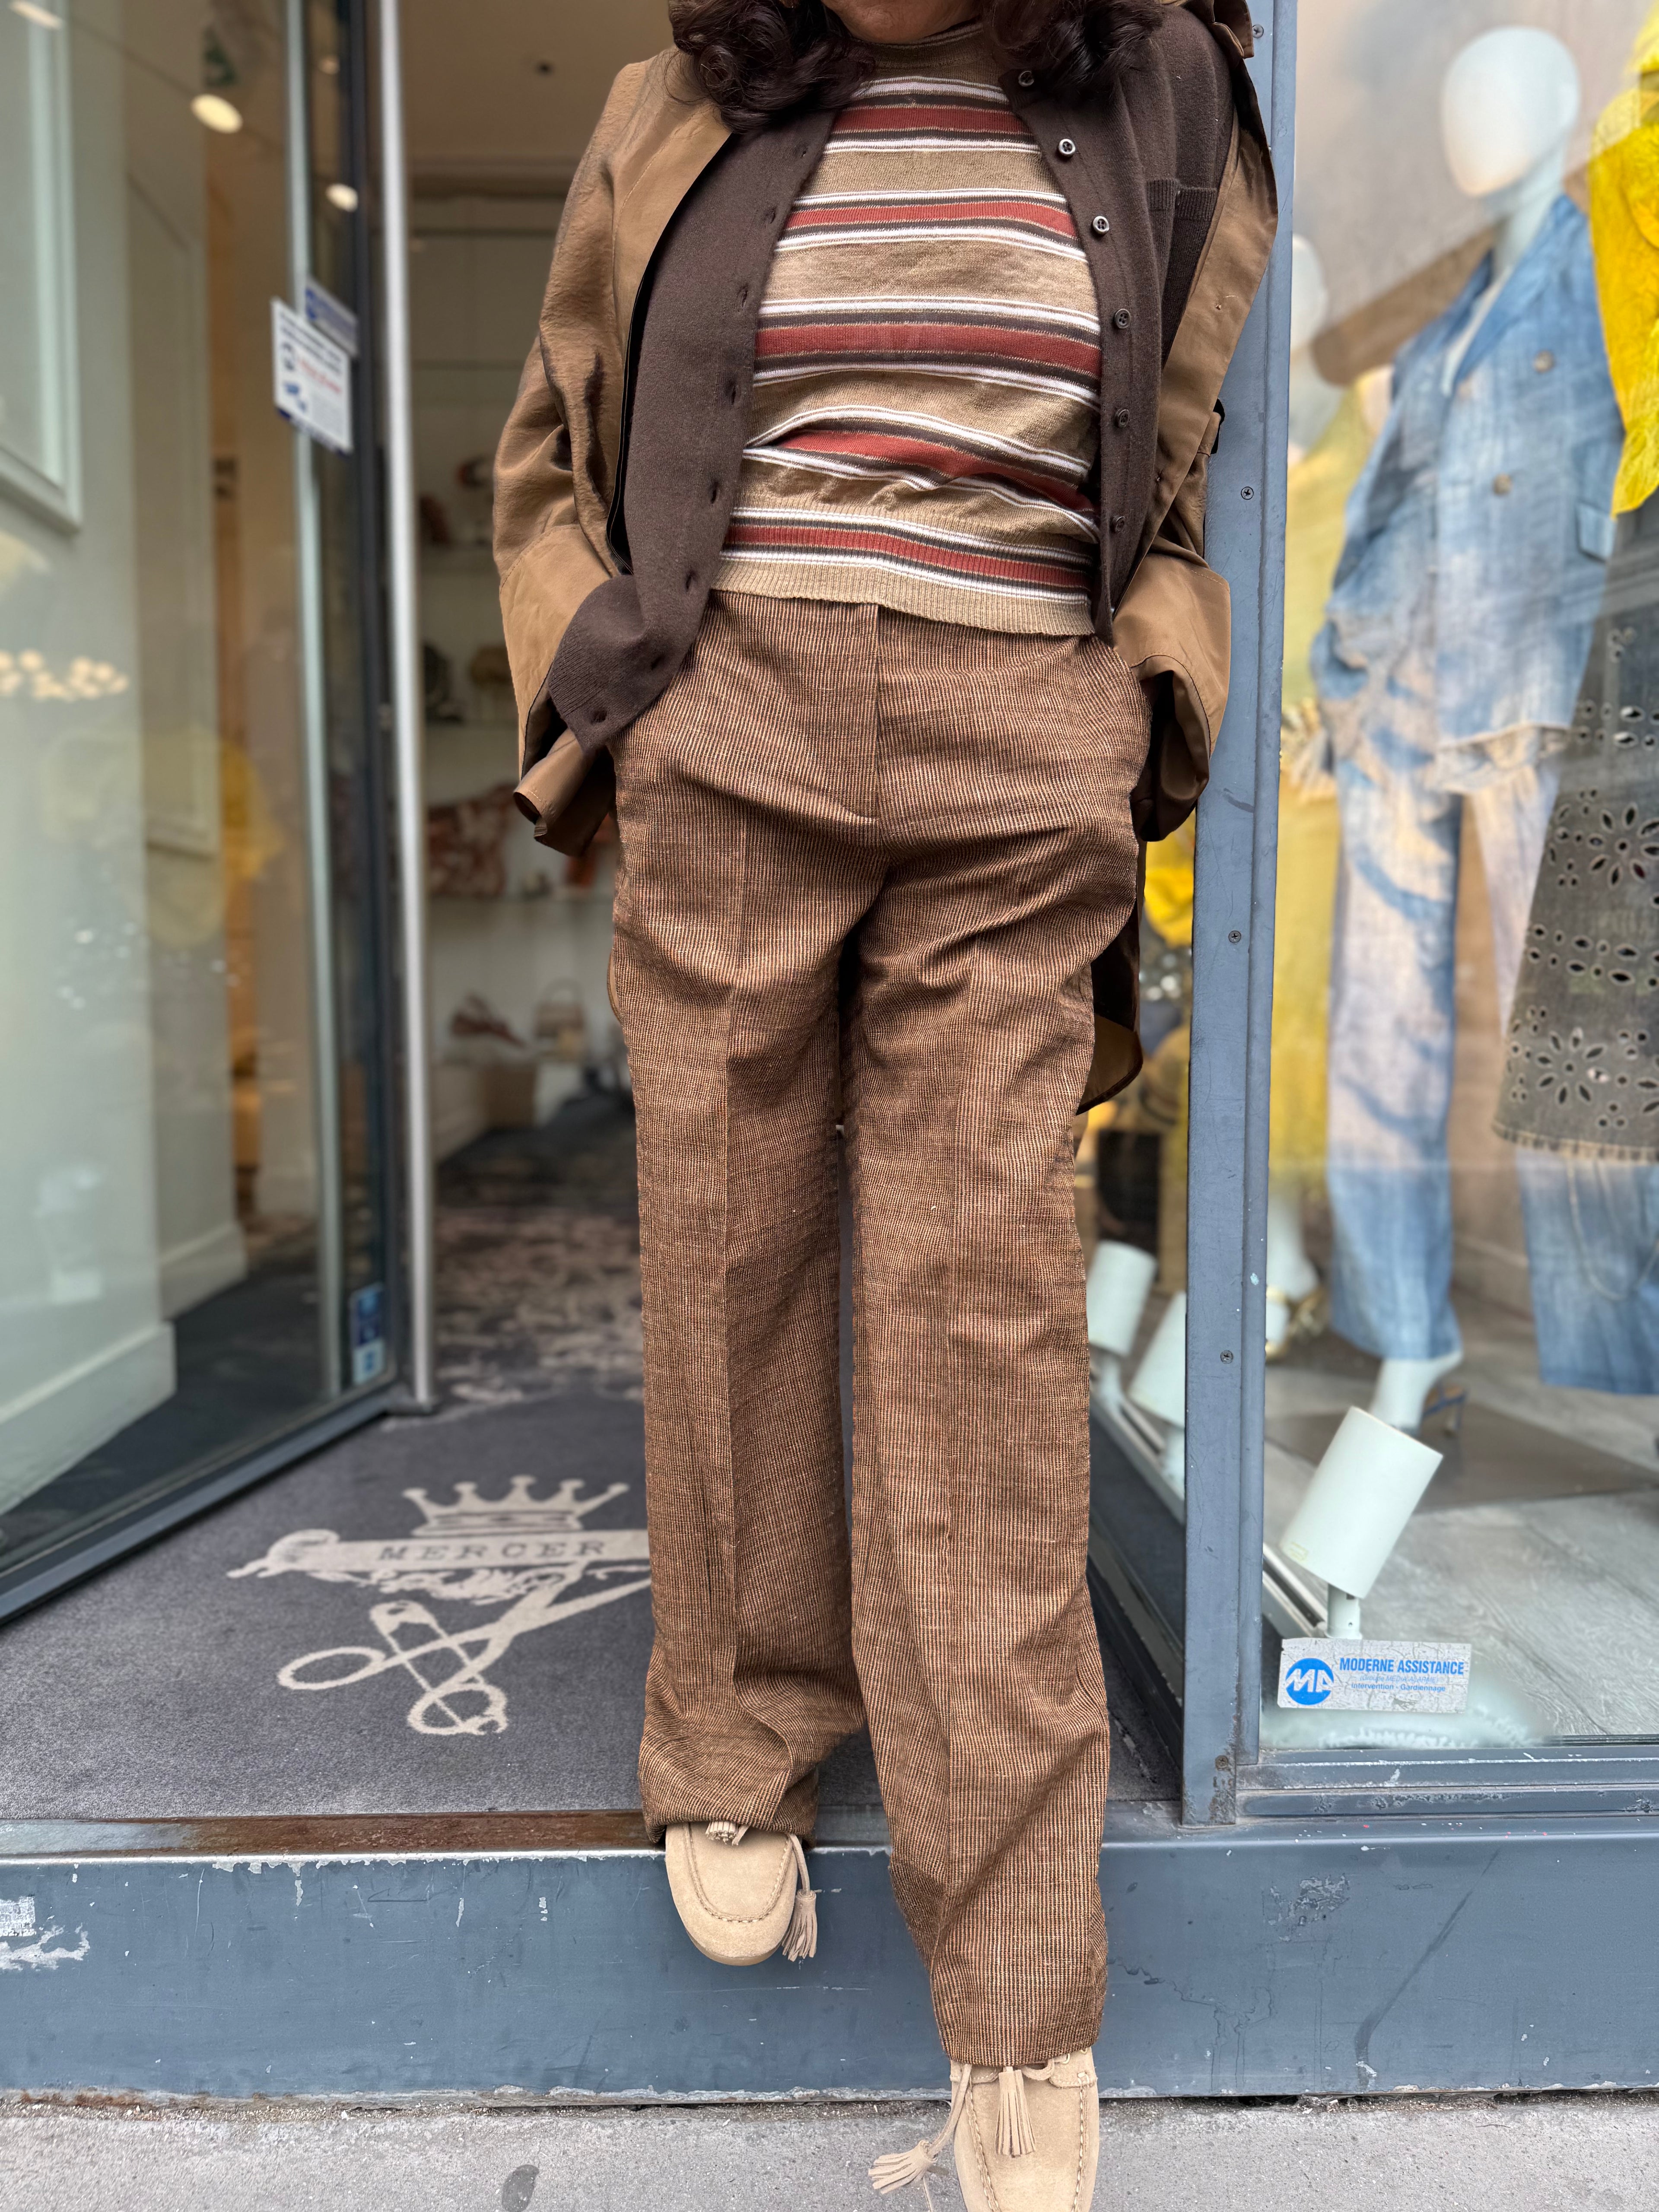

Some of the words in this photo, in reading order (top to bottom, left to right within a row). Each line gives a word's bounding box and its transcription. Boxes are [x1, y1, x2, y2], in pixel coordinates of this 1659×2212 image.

[380, 1540, 604, 1561] MERCER
[1339, 1657, 1394, 1672] MODERNE
[1397, 1660, 1464, 1675] ASSISTANCE
[1285, 1669, 1333, 1693] MA
[1400, 1684, 1446, 1693] Gardiennage
